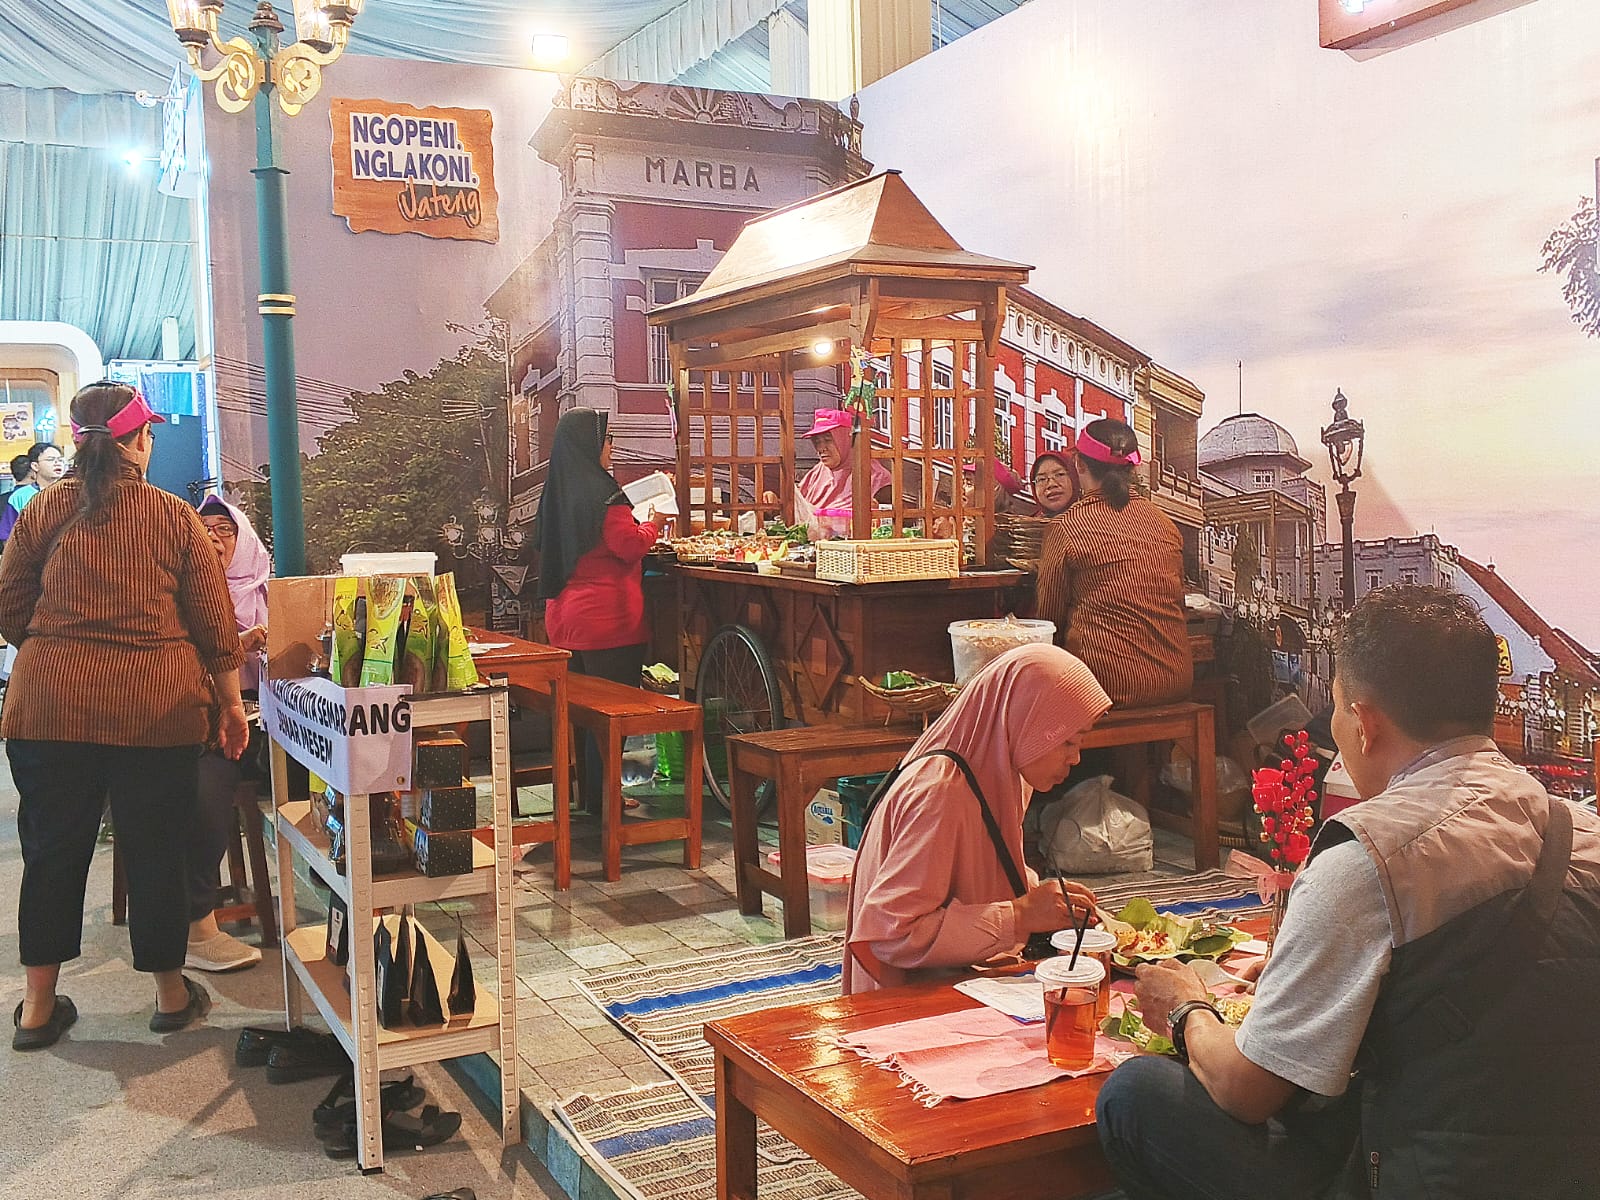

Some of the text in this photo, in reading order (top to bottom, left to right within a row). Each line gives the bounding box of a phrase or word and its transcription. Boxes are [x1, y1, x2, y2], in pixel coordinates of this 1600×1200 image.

[353, 115, 462, 150] NGOPENI.
[354, 149, 477, 184] NGLAKONI.
[645, 156, 760, 192] MARBA
[401, 176, 480, 226] Jateng
[298, 687, 319, 724] KOTA
[317, 695, 411, 737] SEMARANG
[276, 707, 333, 769] SEMAR MESEM
